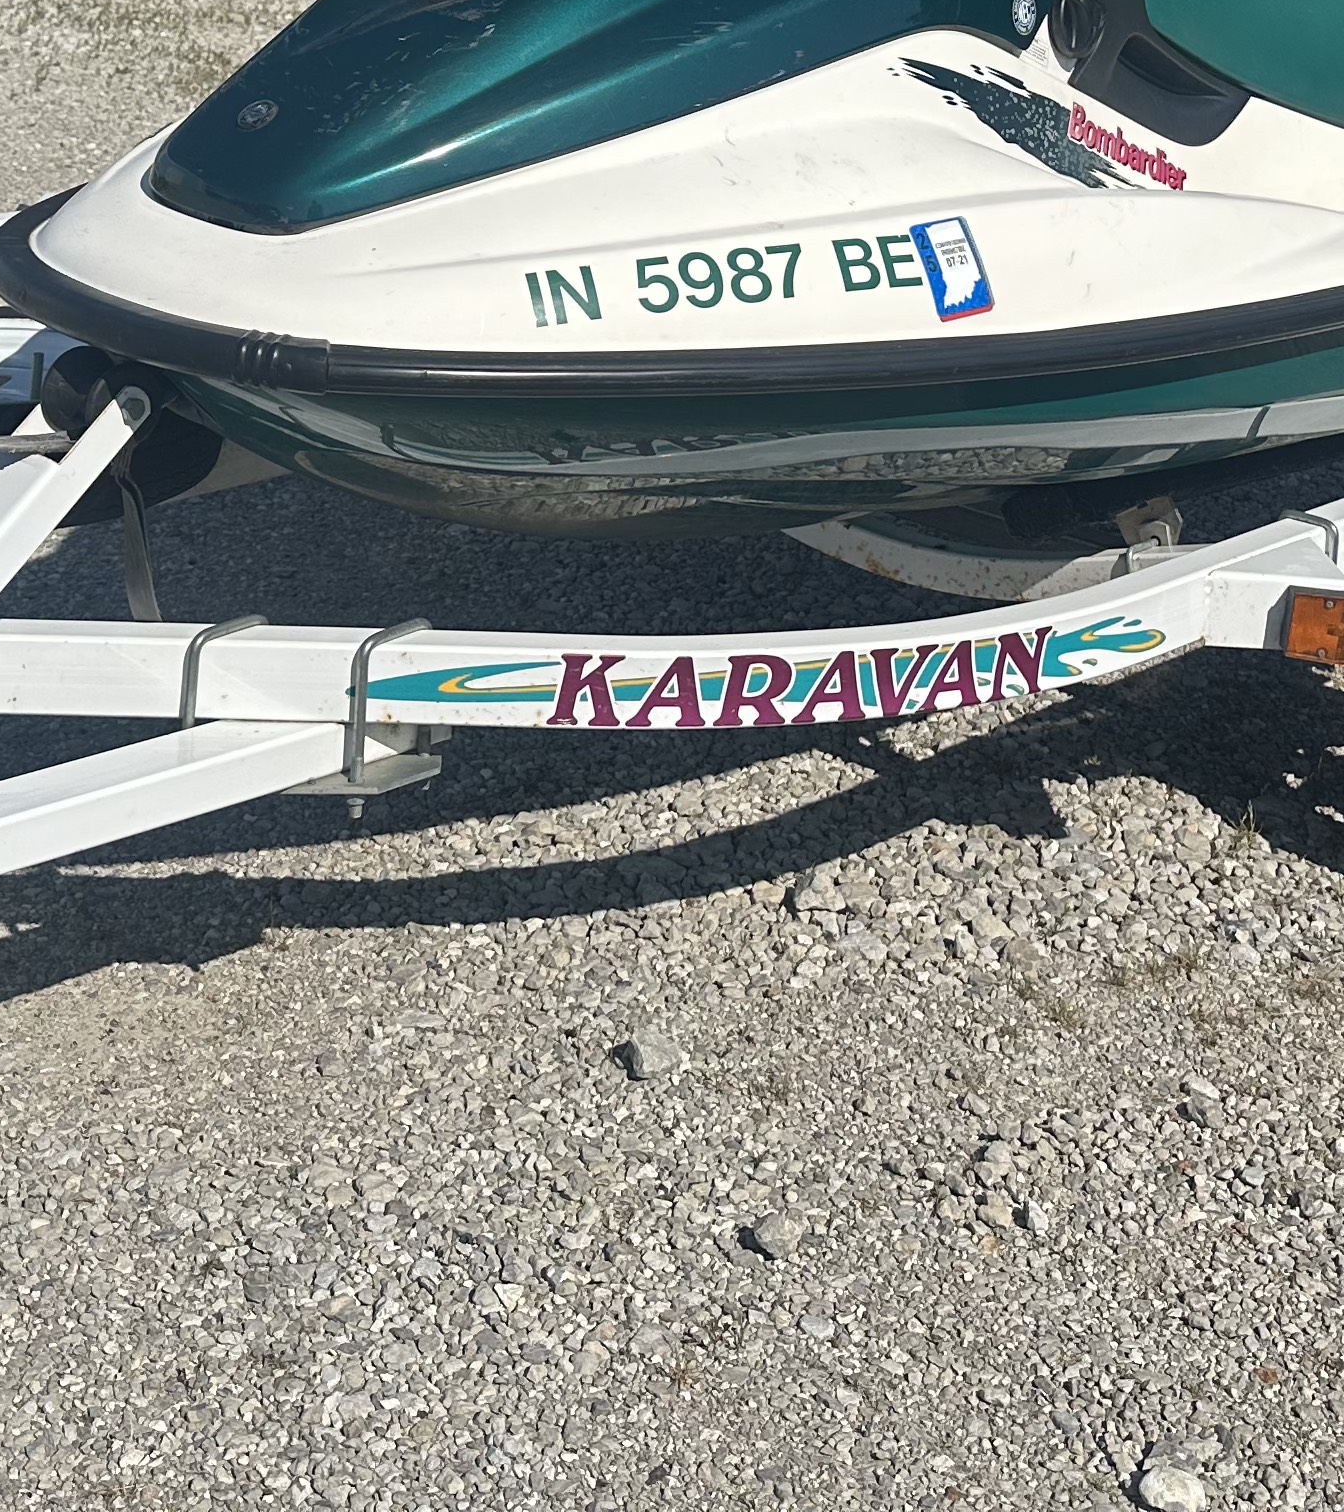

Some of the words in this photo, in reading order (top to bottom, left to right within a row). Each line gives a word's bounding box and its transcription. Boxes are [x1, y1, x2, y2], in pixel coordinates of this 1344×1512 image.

[1068, 101, 1187, 191] Bombardier
[525, 265, 602, 327] IN
[636, 243, 801, 313] 5987
[832, 234, 923, 292] BE
[546, 625, 1053, 728] KARAVAN
